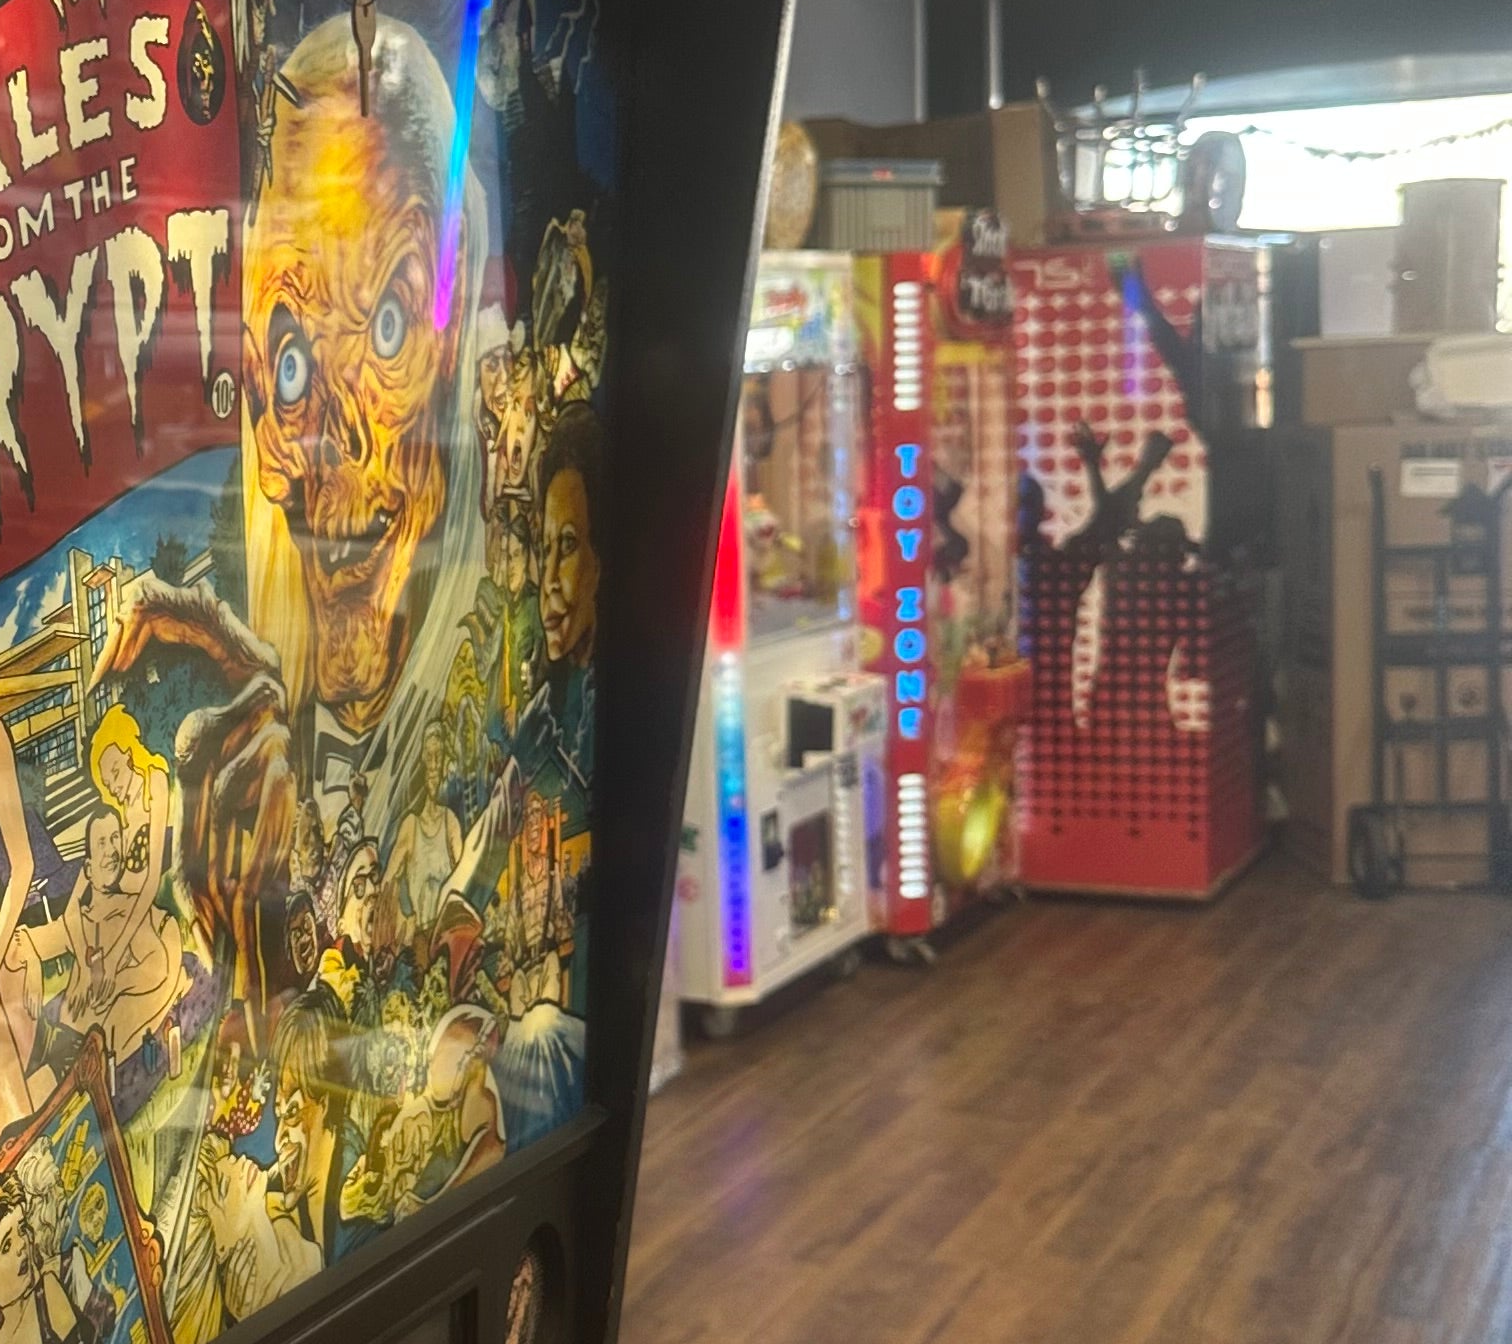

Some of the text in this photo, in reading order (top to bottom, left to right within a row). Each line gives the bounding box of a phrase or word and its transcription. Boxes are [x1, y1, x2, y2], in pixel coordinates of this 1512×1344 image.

[64, 157, 138, 223] THE
[892, 442, 927, 742] TOY ZONE
